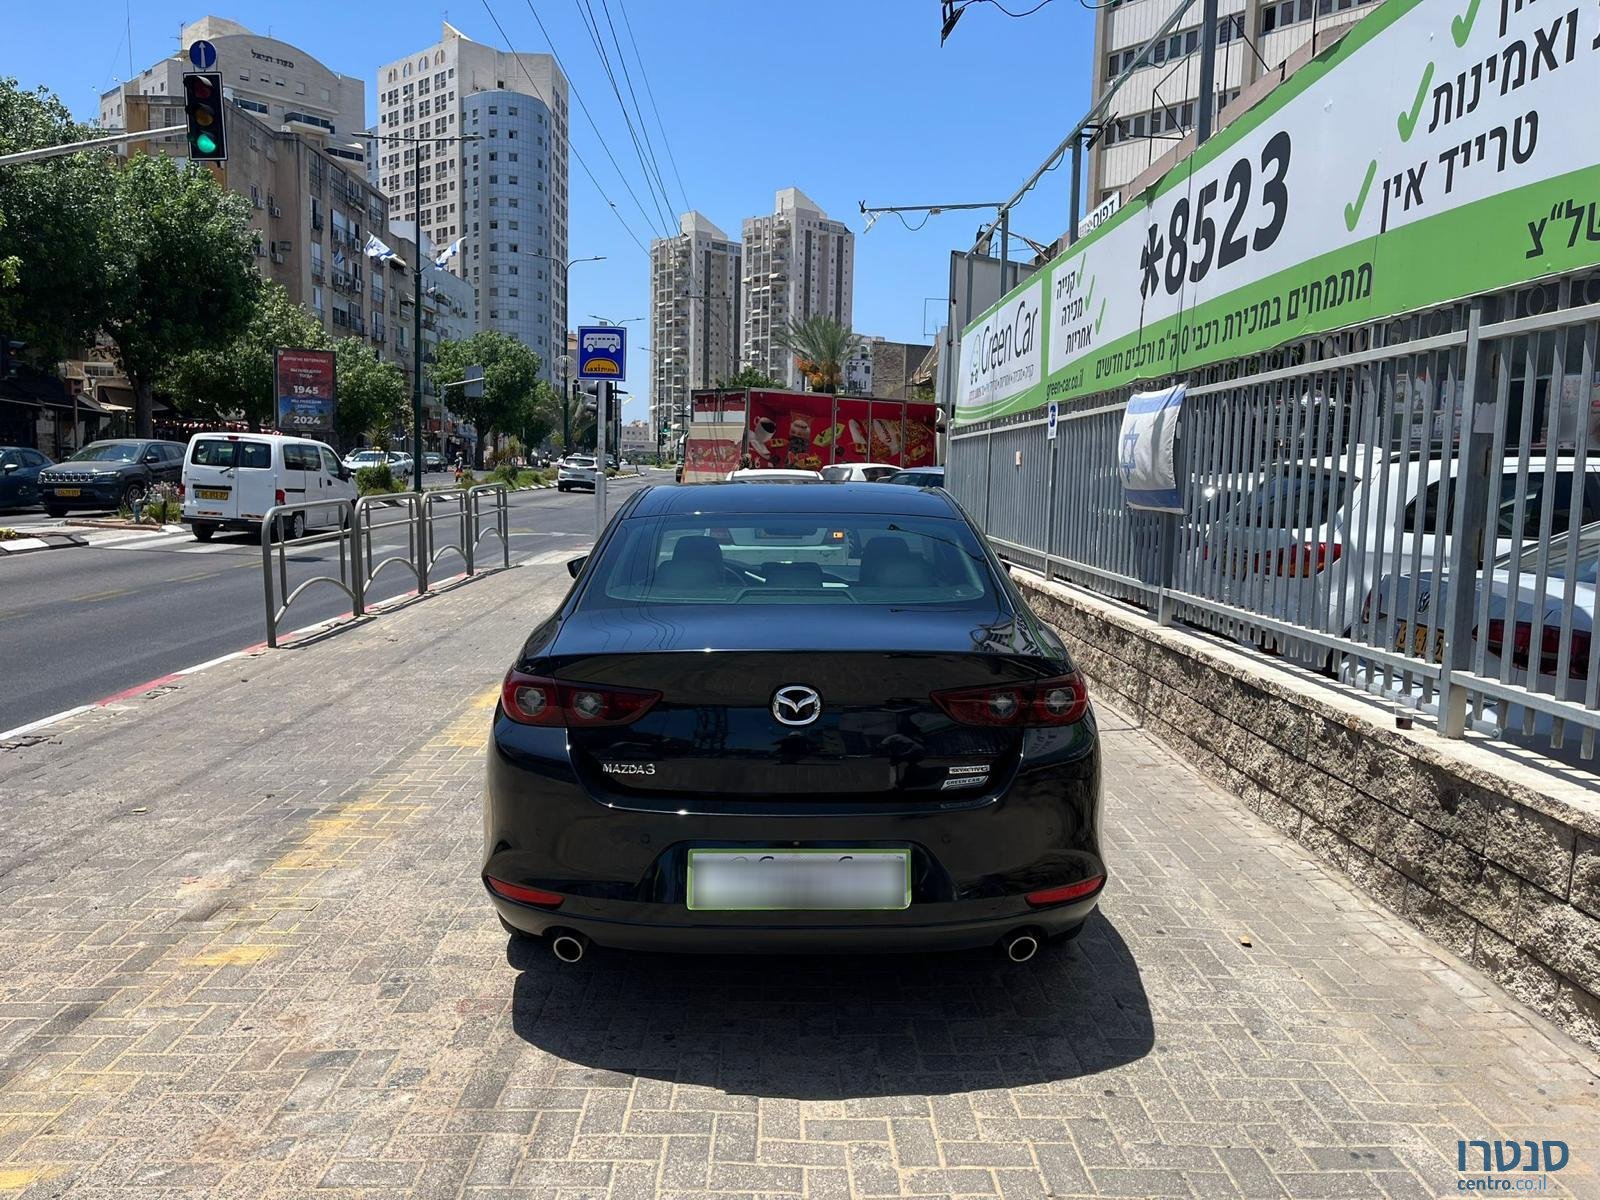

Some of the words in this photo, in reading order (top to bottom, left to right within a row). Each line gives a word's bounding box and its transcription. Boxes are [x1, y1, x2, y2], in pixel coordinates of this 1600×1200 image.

[1428, 8, 1579, 134] ואמינות
[1438, 110, 1539, 194] טרייד
[1380, 160, 1428, 235] אין
[1056, 271, 1076, 300] קנייה
[1287, 262, 1373, 321] מתמחים
[1061, 296, 1083, 326] מכירה
[1223, 294, 1282, 342] במכירת
[981, 325, 1012, 375] Green
[1014, 300, 1039, 358] Car
[1065, 323, 1093, 354] אחריות
[1192, 318, 1219, 351] רכבי
[1096, 352, 1123, 379] חדשים
[1125, 341, 1156, 370] ורכבים
[293, 385, 319, 395] 1945
[1046, 368, 1085, 401] green-car.co.il
[293, 416, 321, 425] 2024
